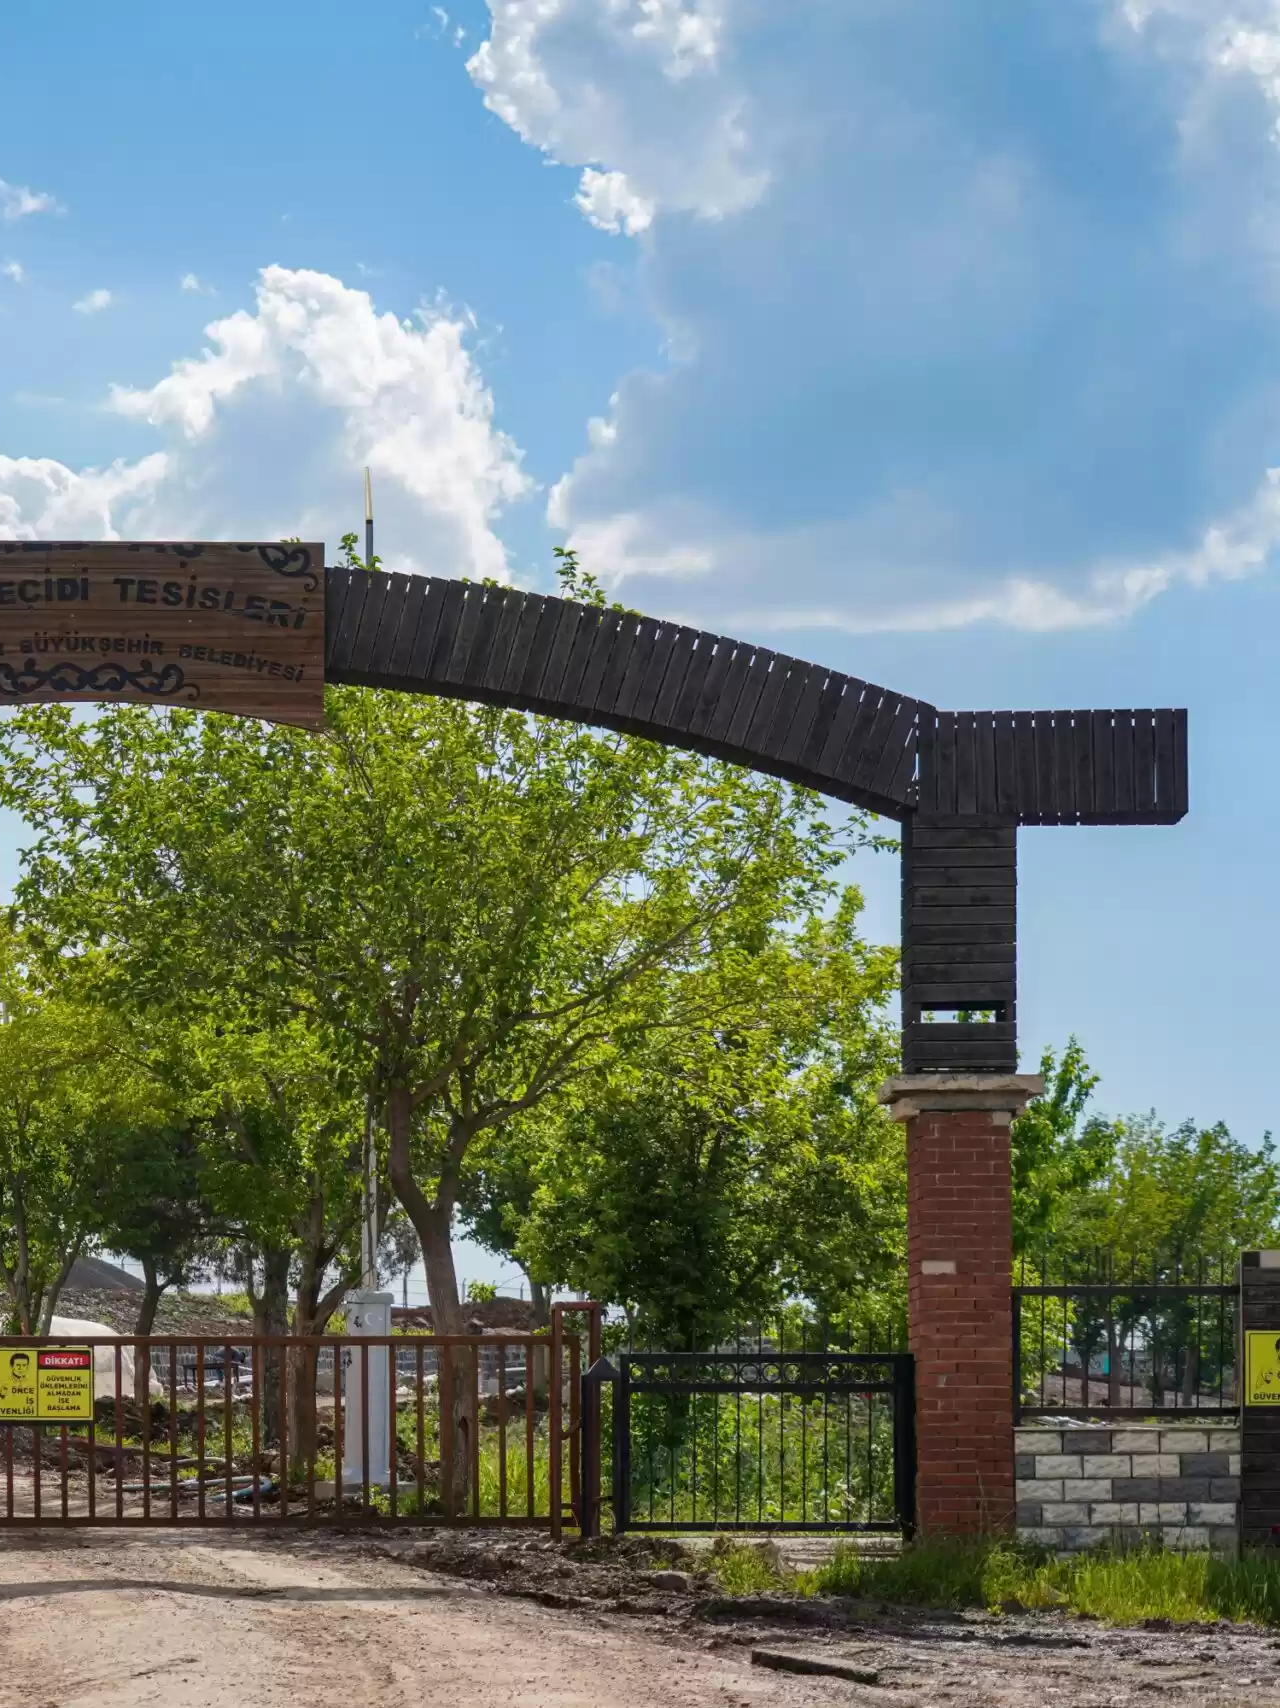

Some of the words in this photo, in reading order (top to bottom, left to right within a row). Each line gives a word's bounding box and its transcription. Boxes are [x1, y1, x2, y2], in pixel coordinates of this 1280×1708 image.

[20, 631, 164, 658] BÜYÜKŞEHİR
[179, 644, 306, 683] BELEDİYESİ
[45, 1356, 83, 1365] DİKKAT!
[11, 1385, 35, 1394] ÖNCE
